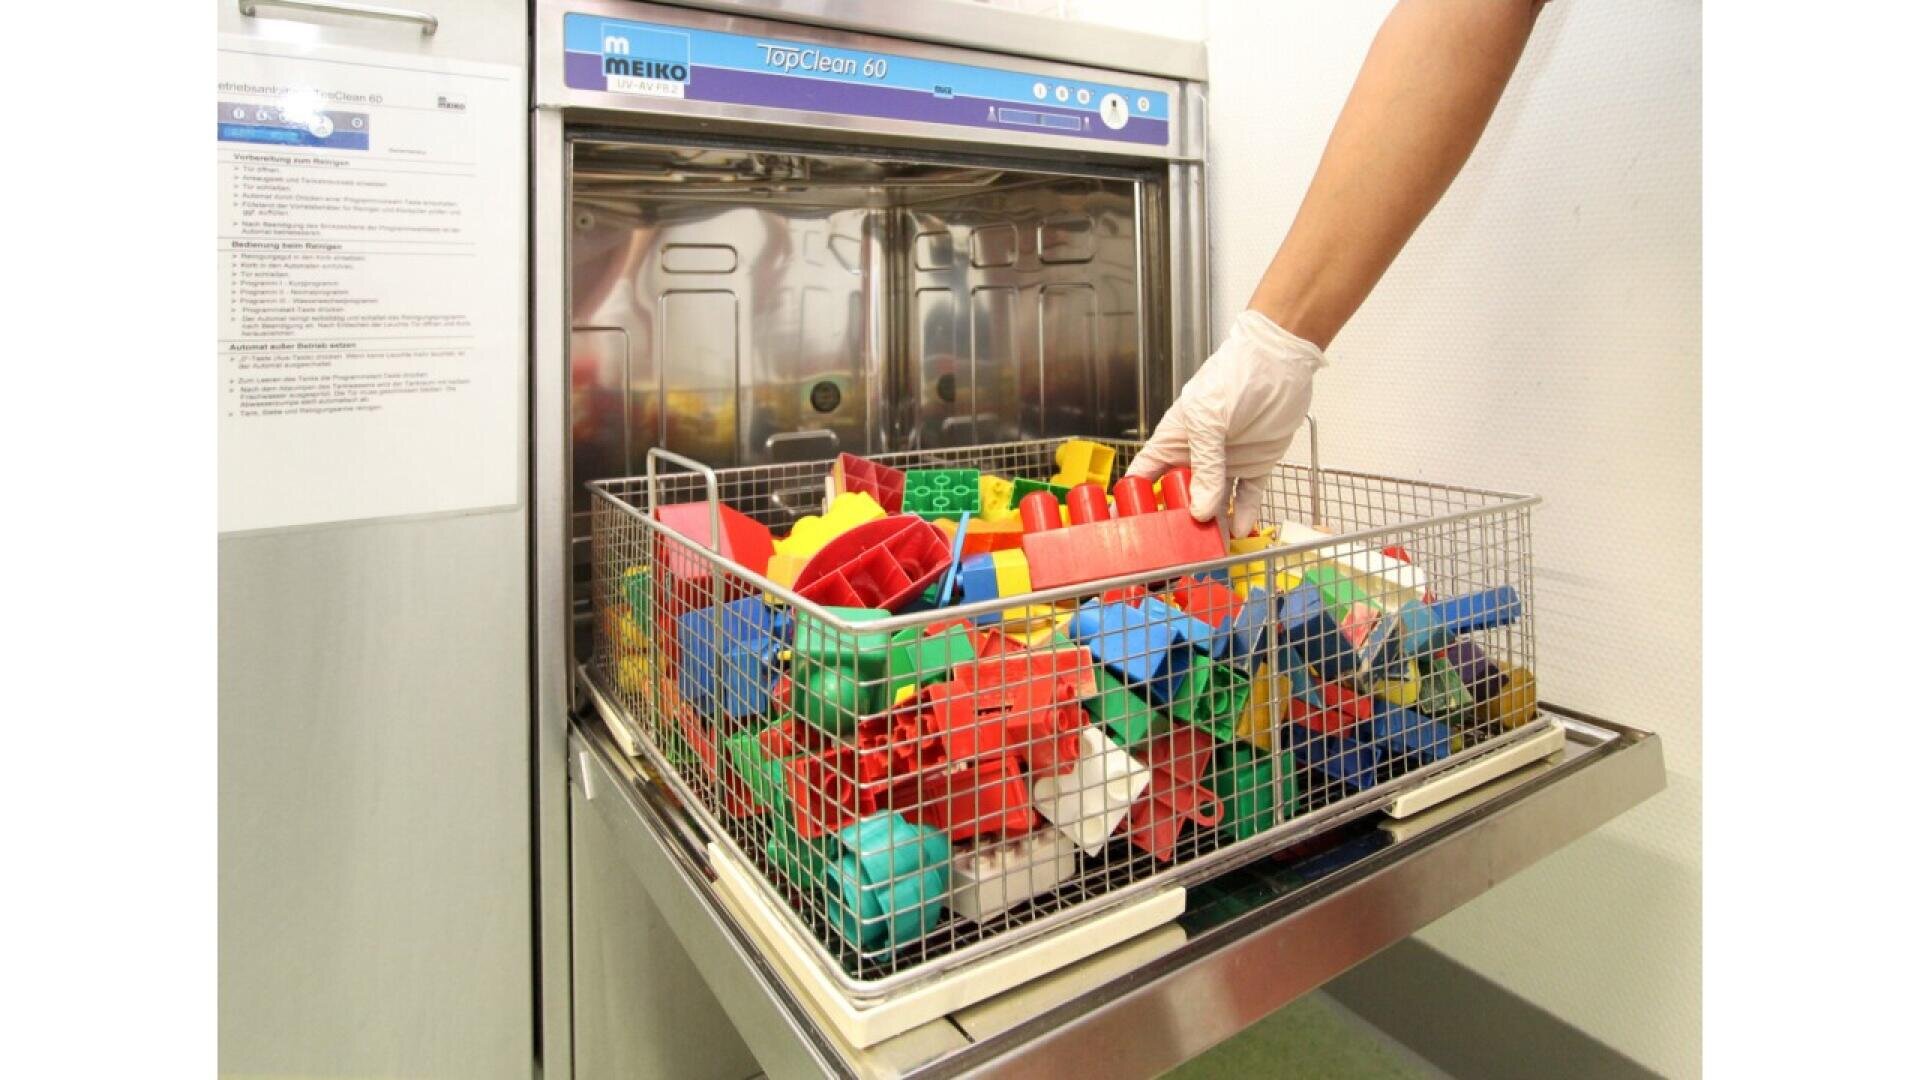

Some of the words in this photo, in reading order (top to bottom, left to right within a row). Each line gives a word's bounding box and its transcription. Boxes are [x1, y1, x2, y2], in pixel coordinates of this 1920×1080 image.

[757, 42, 856, 75] TopClean
[863, 58, 887, 78] 60
[605, 58, 687, 81] MEIKO
[233, 153, 291, 164] Vorbereitung
[313, 158, 350, 167] Reinigen
[232, 241, 280, 251] Bedienung
[306, 242, 343, 252] Reinigen
[270, 342, 295, 350] außer
